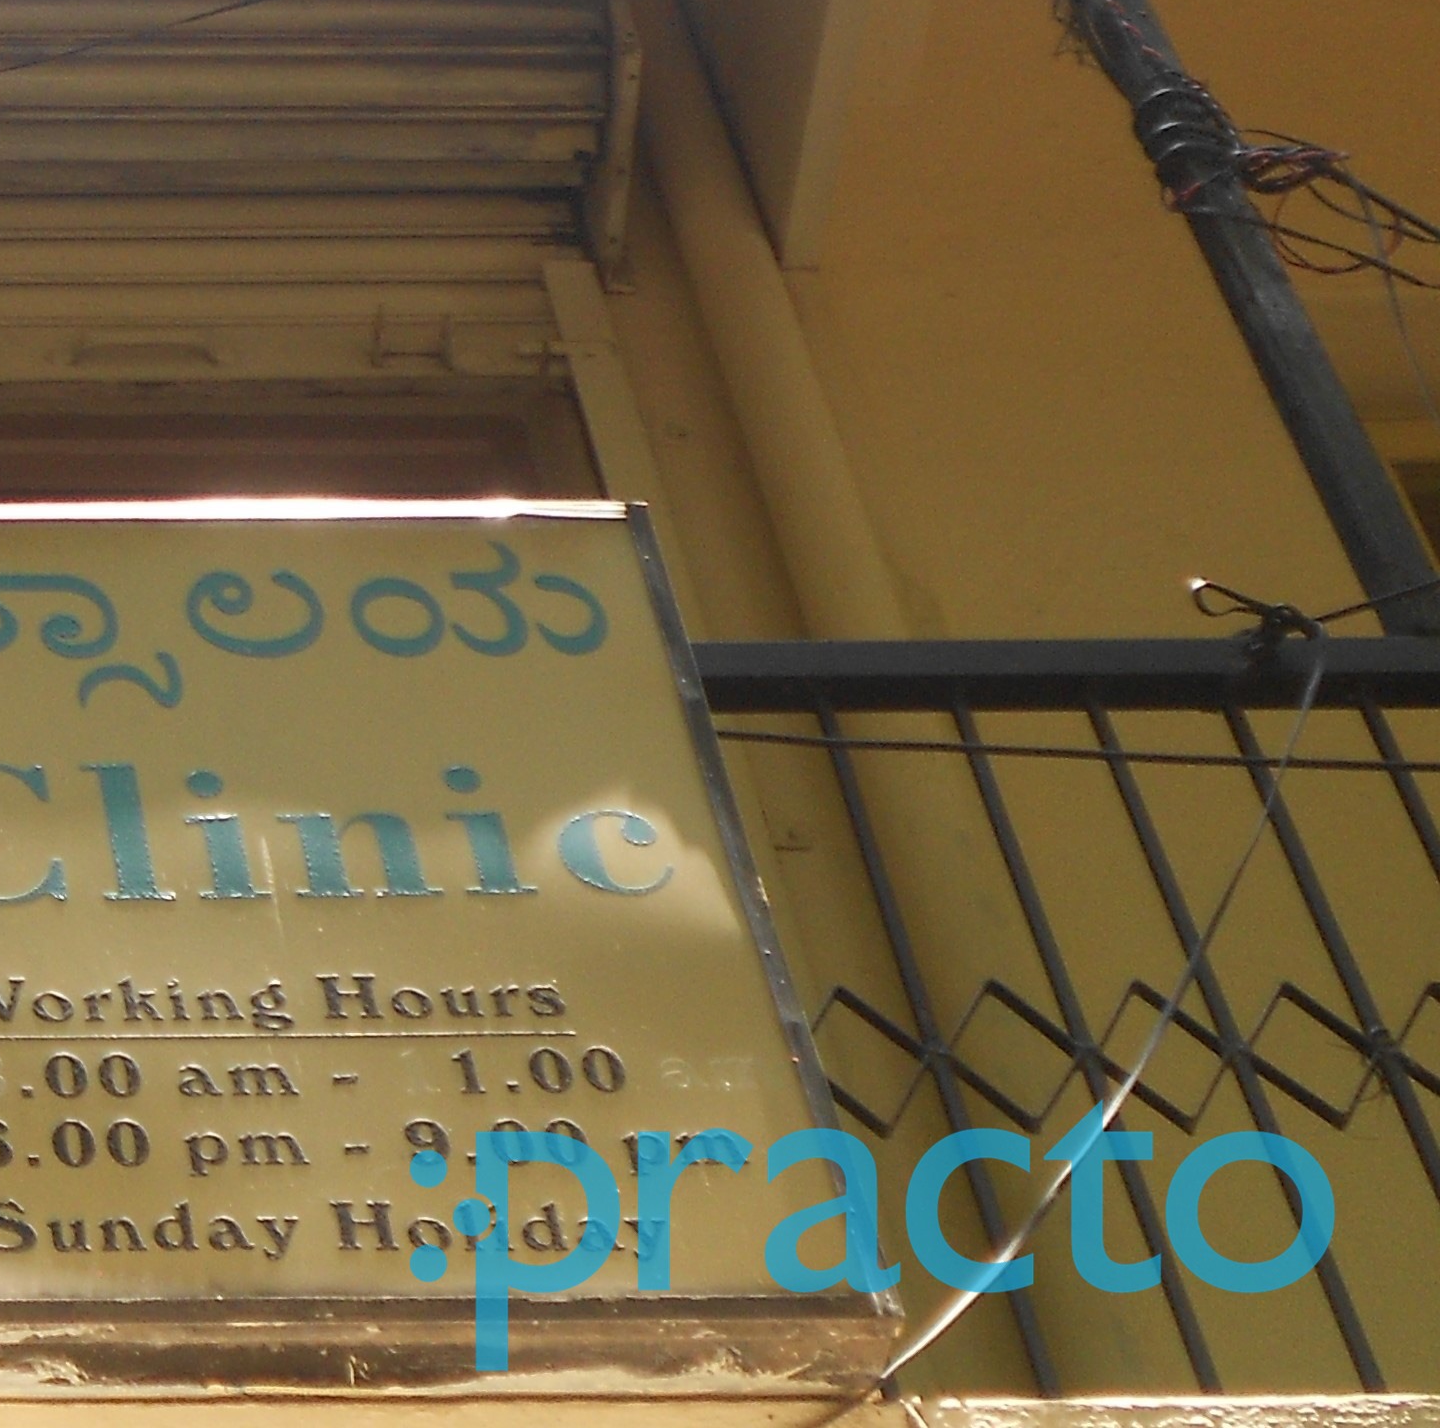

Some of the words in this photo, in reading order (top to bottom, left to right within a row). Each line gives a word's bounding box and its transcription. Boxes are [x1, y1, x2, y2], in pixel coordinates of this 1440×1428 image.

[315, 972, 568, 1021] Hours
[177, 1062, 300, 1098] am
[183, 1126, 311, 1178] pm
[403, 1117, 589, 1167] 9.00
[623, 1130, 750, 1175] pm
